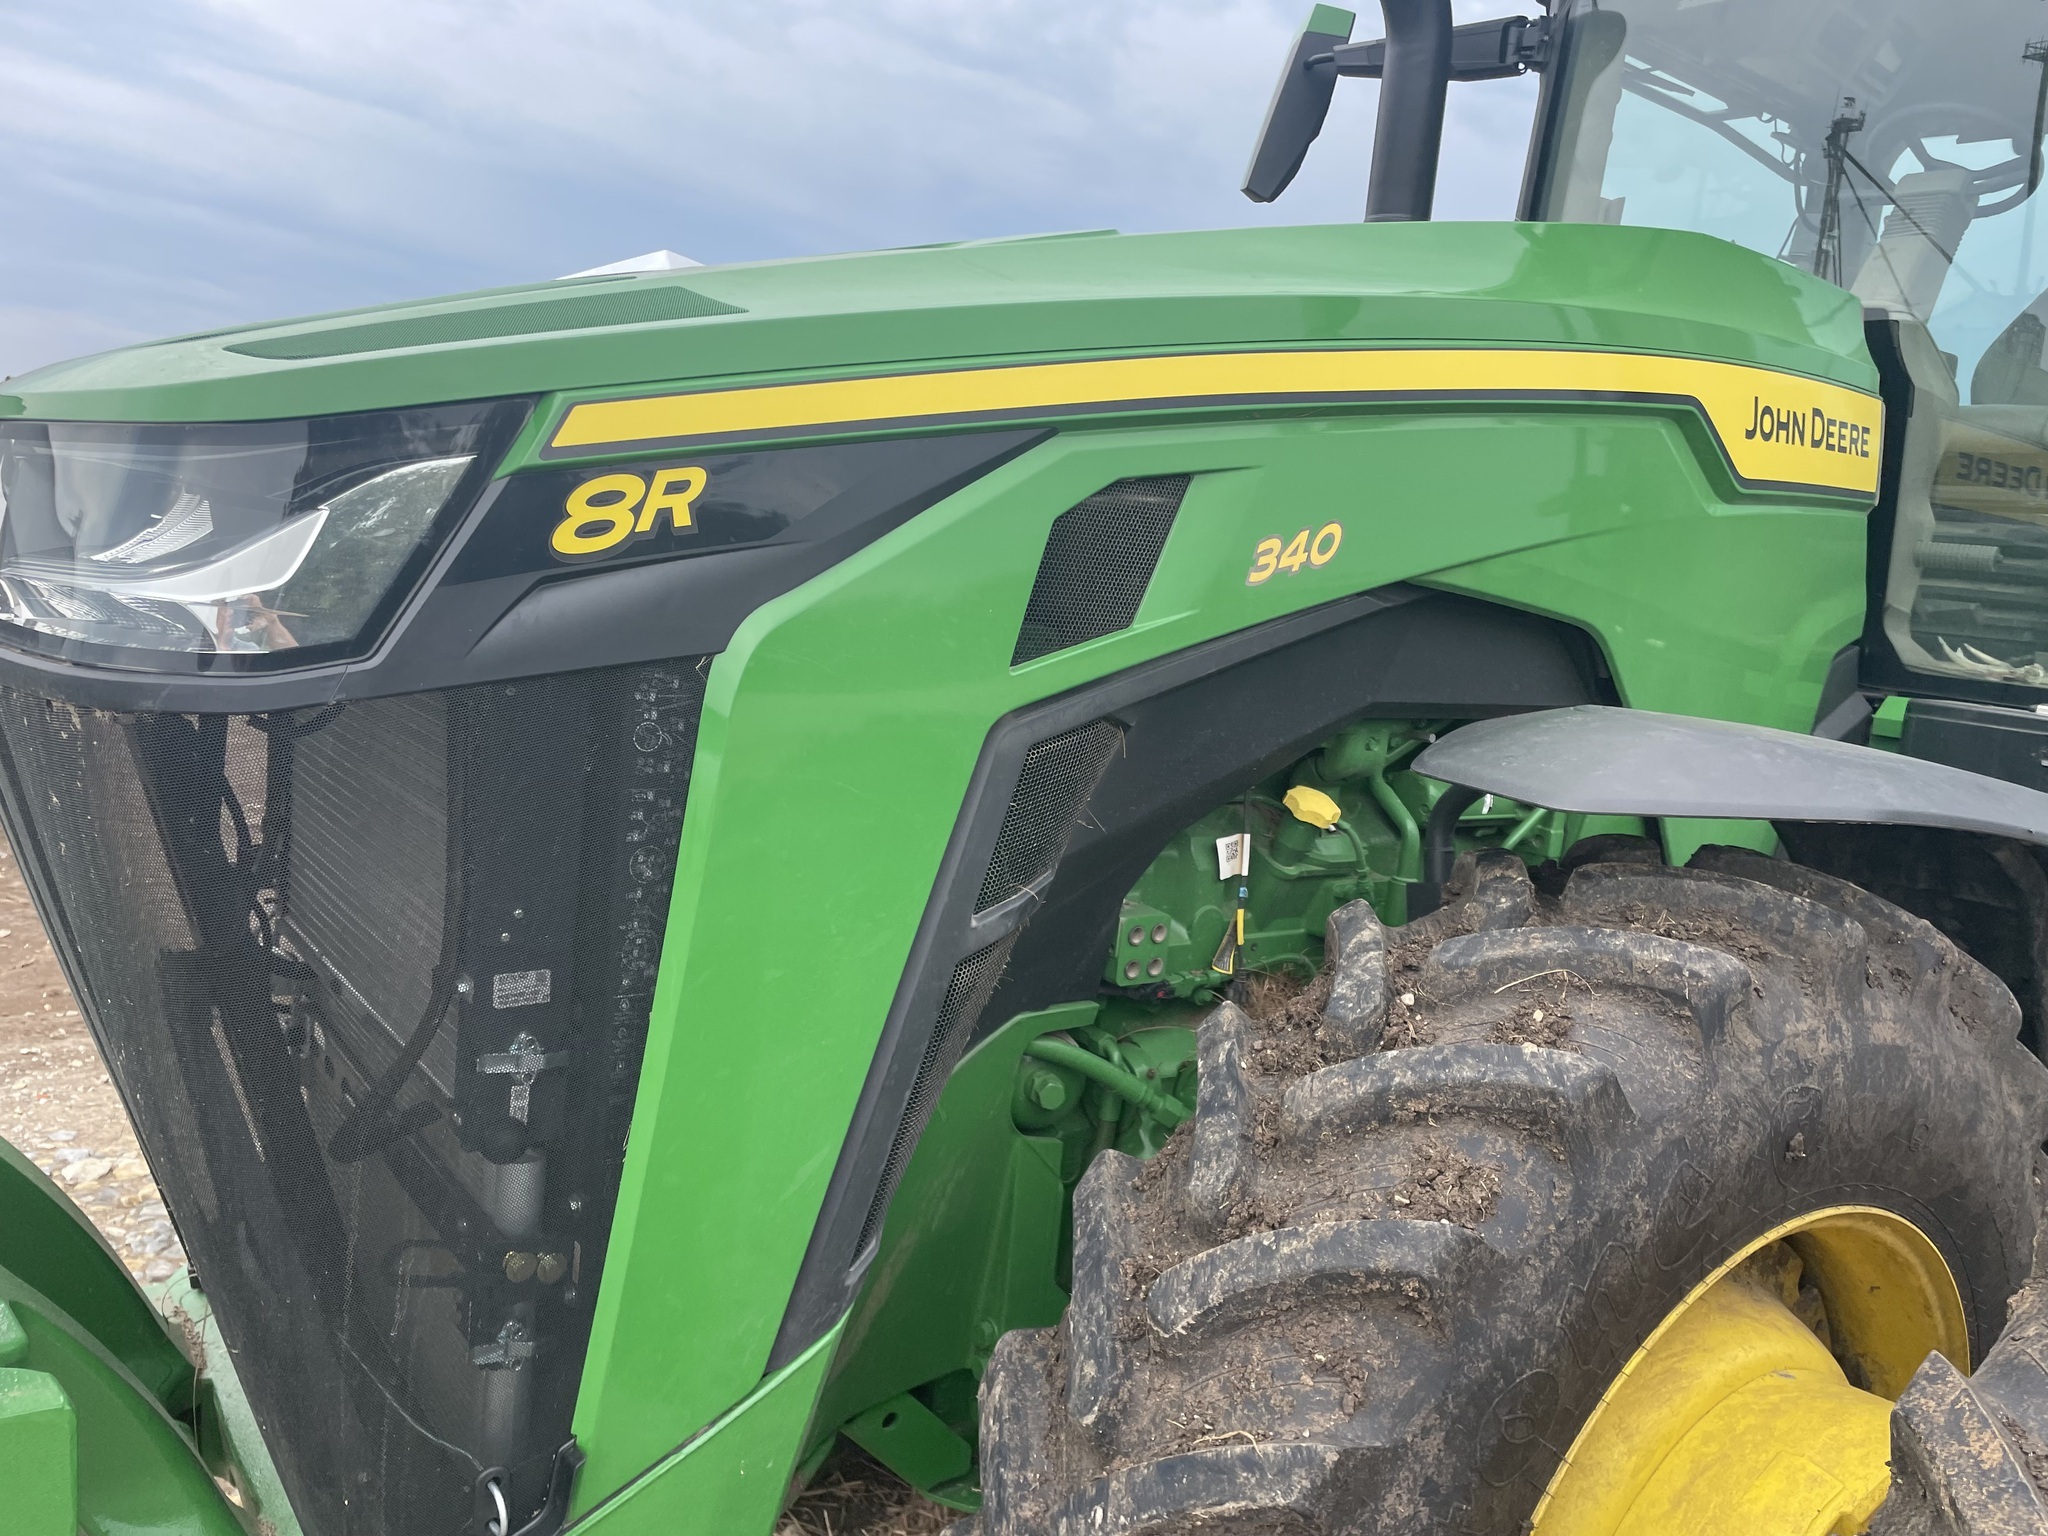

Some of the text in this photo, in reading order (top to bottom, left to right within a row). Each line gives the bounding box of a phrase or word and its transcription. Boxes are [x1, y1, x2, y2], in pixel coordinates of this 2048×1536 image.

[1745, 396, 1870, 458] JOHN DEERE
[551, 466, 708, 556] 8R
[1247, 521, 1343, 585] 340
